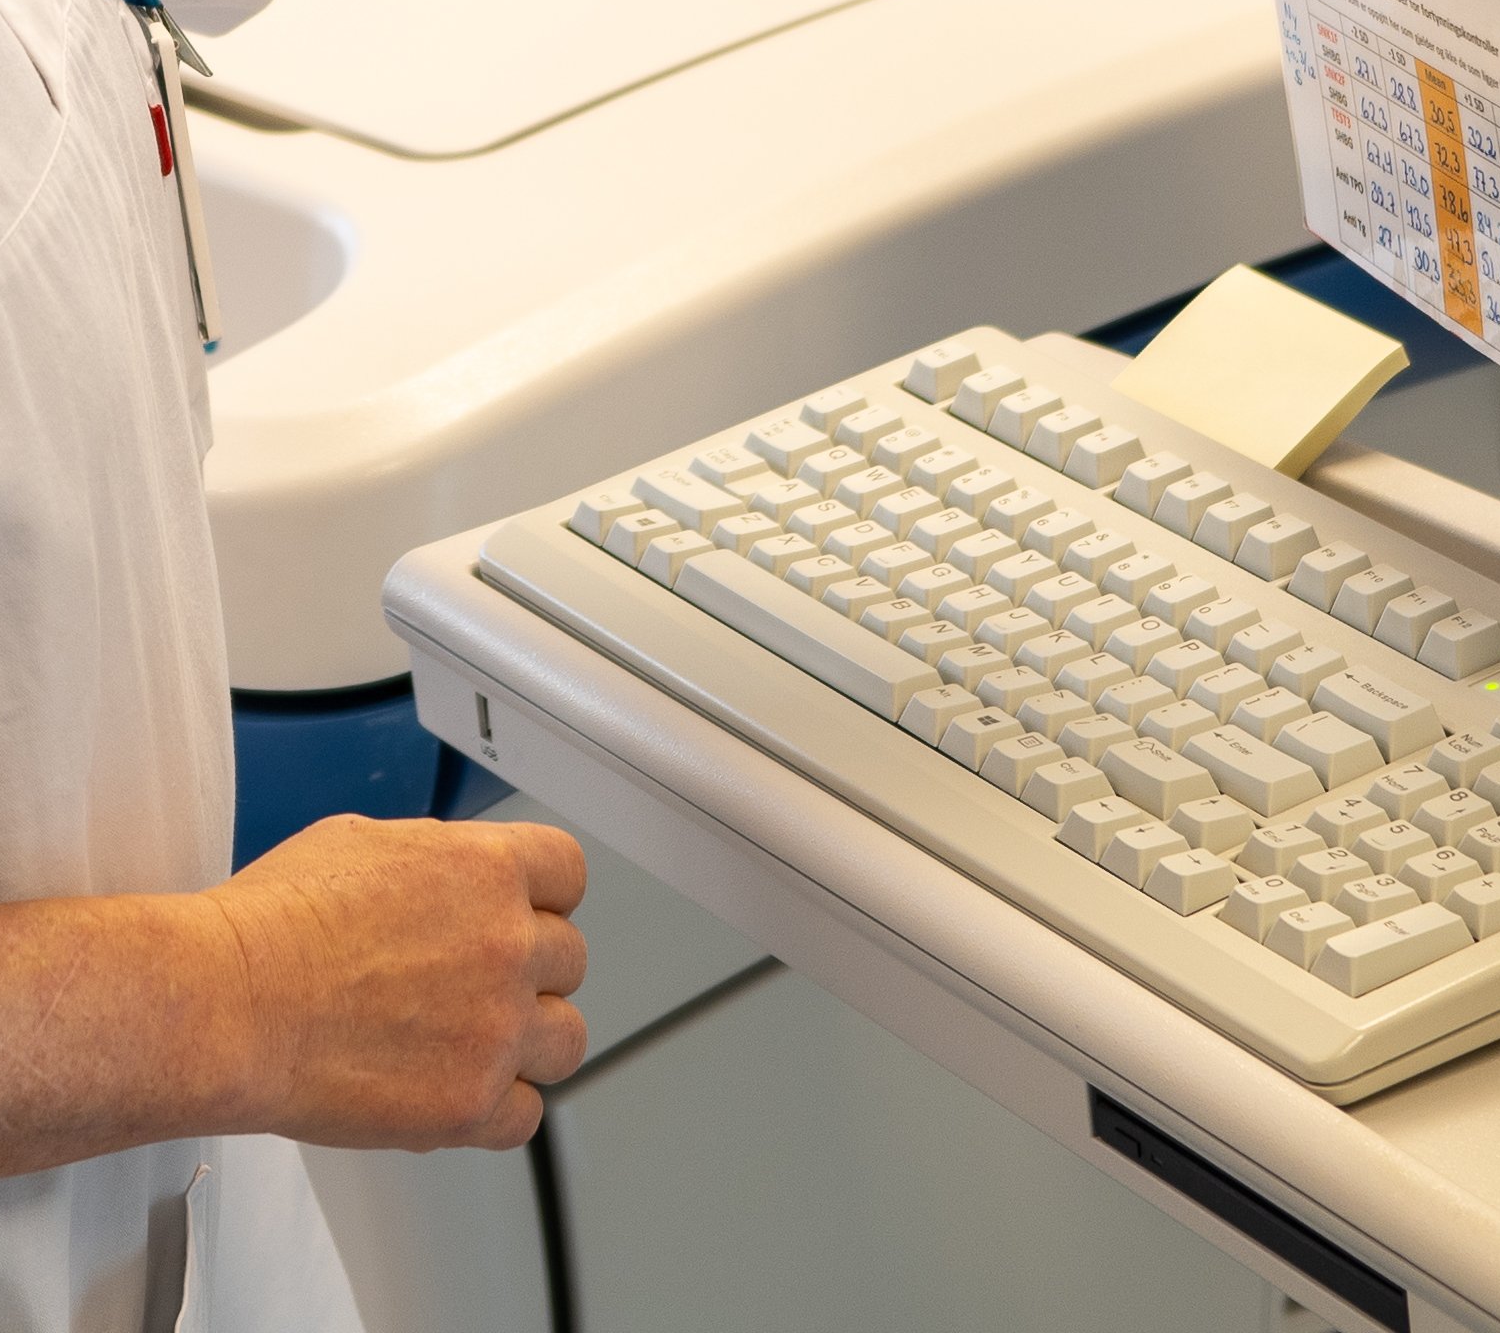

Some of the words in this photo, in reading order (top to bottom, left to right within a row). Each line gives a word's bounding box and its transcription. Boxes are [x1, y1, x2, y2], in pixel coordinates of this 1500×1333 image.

[1424, 68, 1447, 90] Mean
[1349, 173, 1365, 195] TPO
[829, 449, 848, 460] Q
[866, 469, 892, 483] W
[779, 482, 798, 493] A
[900, 492, 918, 502] E
[817, 501, 836, 512] S
[939, 511, 960, 524] R
[853, 522, 873, 533] D
[776, 535, 798, 546] X
[978, 532, 998, 543] T
[816, 557, 837, 567] C
[1019, 554, 1037, 564] Y
[931, 567, 952, 578] G
[1364, 570, 1384, 584] F10
[855, 577, 875, 588] V
[1058, 576, 1079, 587] U
[968, 587, 992, 599] H
[890, 599, 912, 610] B
[1407, 592, 1427, 606] F11
[1009, 612, 1028, 620] J
[1451, 615, 1473, 630] F12
[930, 623, 954, 634] N
[1048, 631, 1072, 643] K
[967, 645, 993, 657] M
[1179, 641, 1200, 652] P
[1090, 654, 1107, 665] L
[1359, 682, 1410, 710] Backspace
[1460, 733, 1484, 749] Num
[1229, 739, 1253, 756] Enter
[1447, 739, 1471, 755] Lock
[1060, 761, 1080, 774] Ctrl
